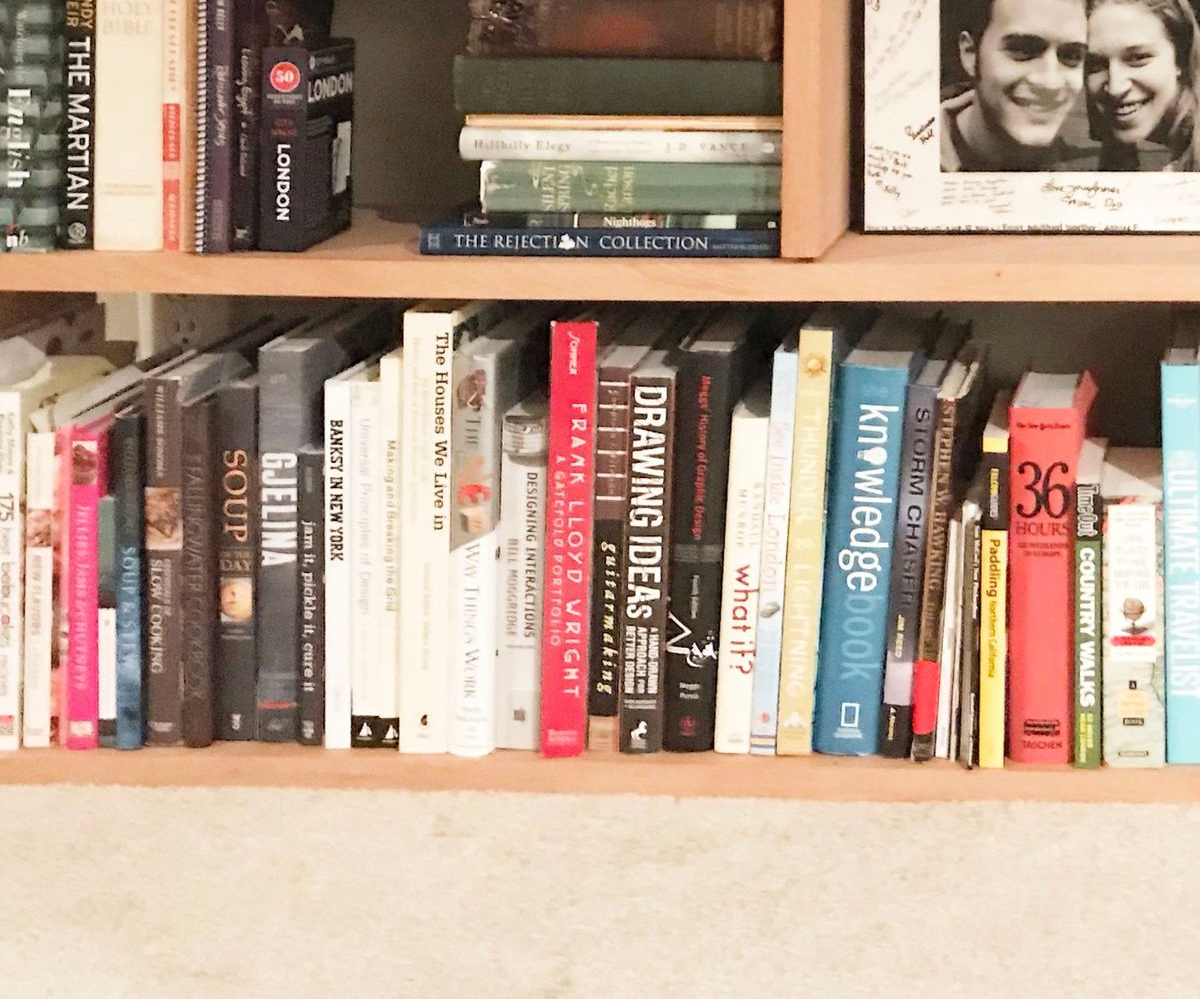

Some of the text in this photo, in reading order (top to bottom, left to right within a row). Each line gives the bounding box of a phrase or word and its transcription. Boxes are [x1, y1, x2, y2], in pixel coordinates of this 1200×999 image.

[66, 36, 91, 211] THE MARTIAN
[307, 71, 353, 103] LONDON
[275, 143, 292, 222] LONDON
[536, 139, 571, 153] Elegy
[454, 234, 488, 250] THE
[493, 234, 589, 250] REJECTIN
[599, 236, 709, 251] COLLECTION
[433, 332, 449, 532] The Houses We Live in
[221, 449, 248, 543] SOUP
[261, 452, 298, 569] GJELINA
[302, 520, 315, 547] jam
[329, 419, 344, 562] BANKSY IN NEW YORK
[355, 418, 373, 616] Universal Principles of Design
[382, 439, 399, 613] Making and Breaking the Grid
[625, 385, 666, 620] DRAWING IDEAS
[899, 406, 932, 610] STORM CHASER
[1016, 461, 1071, 520] 36
[1016, 521, 1070, 536] HOURS
[187, 465, 205, 699] FALLINGWATER COOKBOOK
[301, 572, 317, 621] pickle
[463, 416, 482, 700] THE WAY THINGS WORK
[506, 538, 519, 637] BILL MOGGRIDGE
[524, 472, 538, 639] DESIGNING INTERACTIONS
[562, 402, 588, 698] FRANK LLOYD WRIGHT
[1079, 546, 1096, 638] COUNTRY
[1167, 469, 1200, 700] ULTIMATE TRAVELIST
[150, 559, 163, 674] SLOW COOKING
[303, 642, 315, 678] cure
[598, 541, 619, 696] guitarmaking
[624, 625, 635, 694] BETTER DESIGN
[729, 563, 759, 675] what if?
[303, 680, 317, 693] it
[1079, 641, 1096, 708] WALKS
